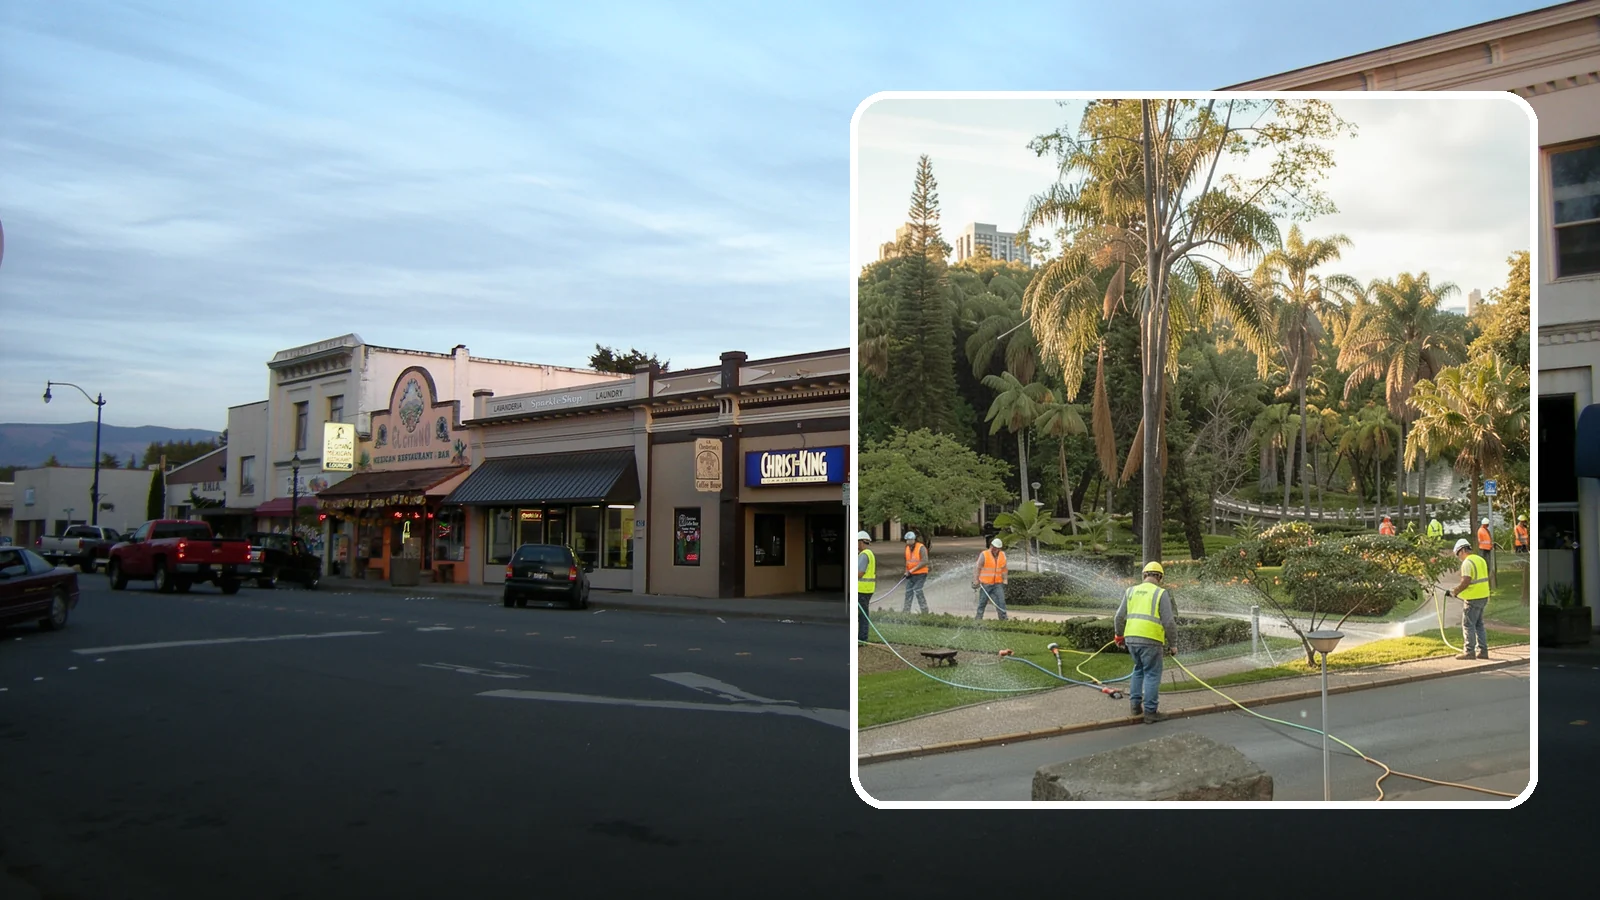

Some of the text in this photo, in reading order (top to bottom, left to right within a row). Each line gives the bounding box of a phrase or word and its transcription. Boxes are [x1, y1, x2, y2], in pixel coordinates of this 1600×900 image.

[530, 394, 583, 409] Sparkle Shop
[595, 389, 624, 400] LAUNDRY
[493, 402, 522, 412] LAVANDERIA
[373, 450, 450, 464] MEXICAN RESTAURANT BAR
[761, 449, 827, 478] CHRIST KING
